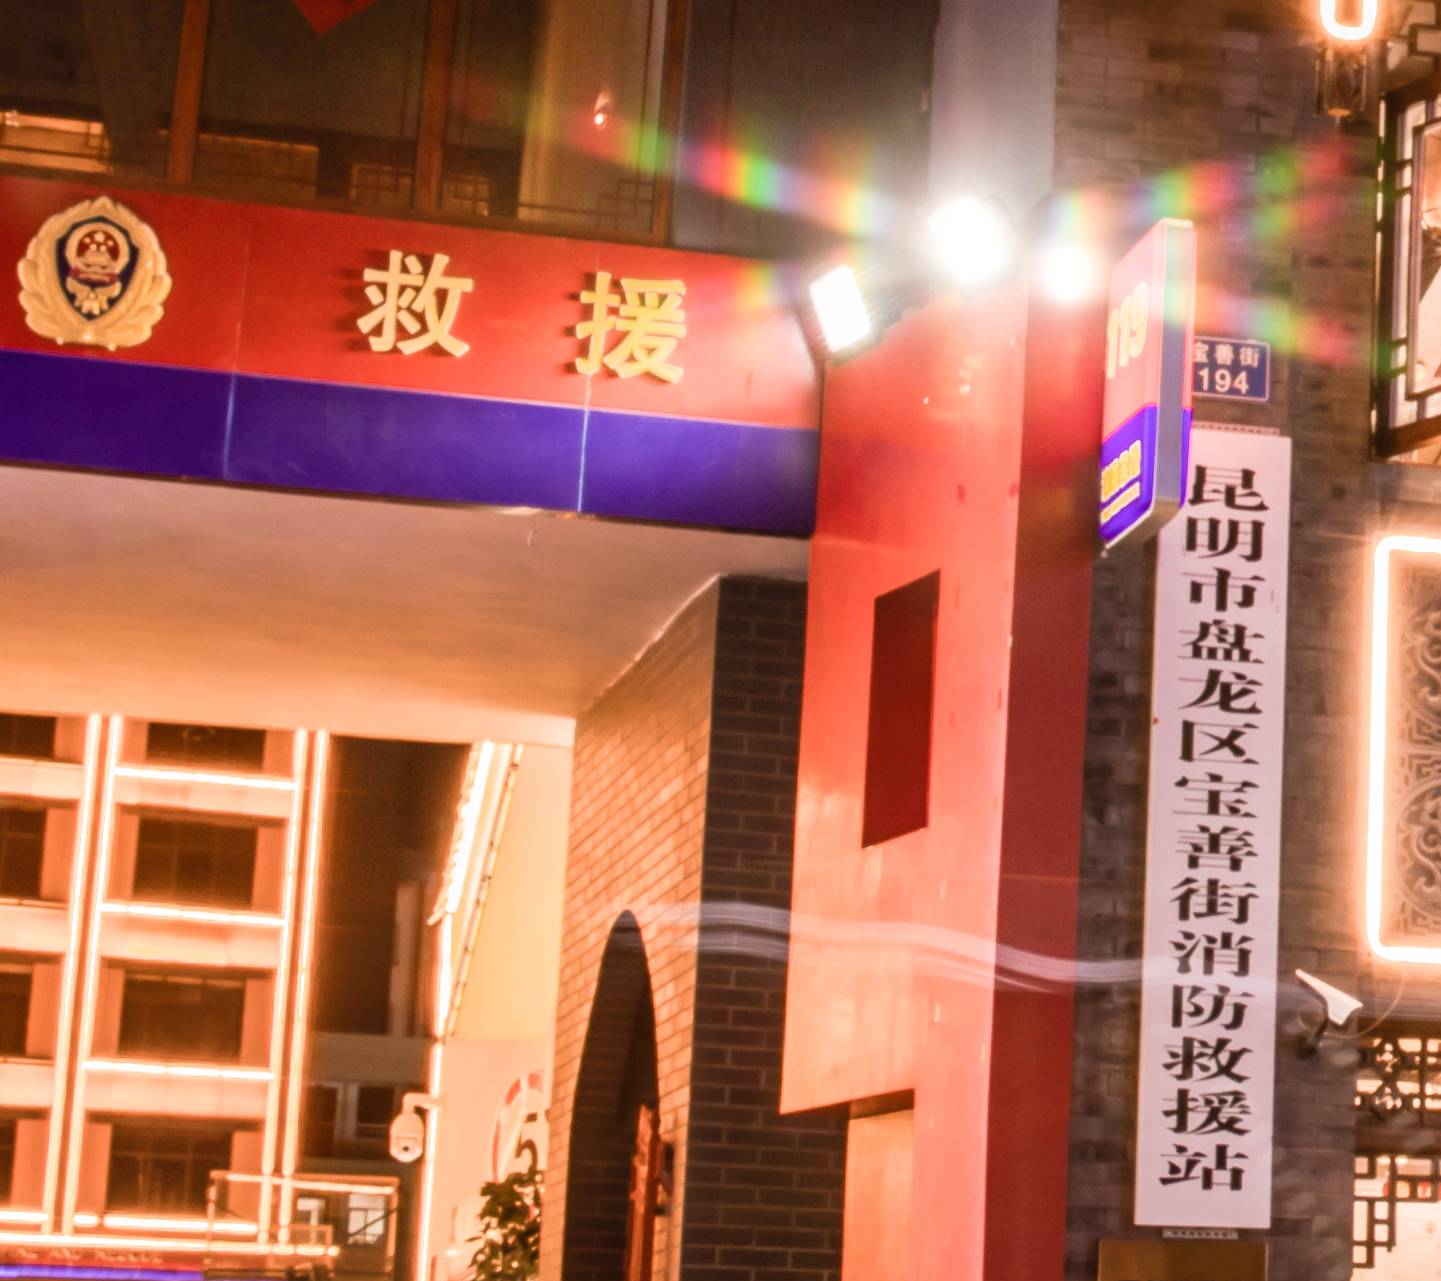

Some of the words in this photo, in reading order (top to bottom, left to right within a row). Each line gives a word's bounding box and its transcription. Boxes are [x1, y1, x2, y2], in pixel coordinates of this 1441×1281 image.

[356, 249, 690, 385] 救援
[1198, 366, 1249, 395] 194
[1159, 463, 1270, 1192] 昆明市盘龙区宝善街消防救援站
